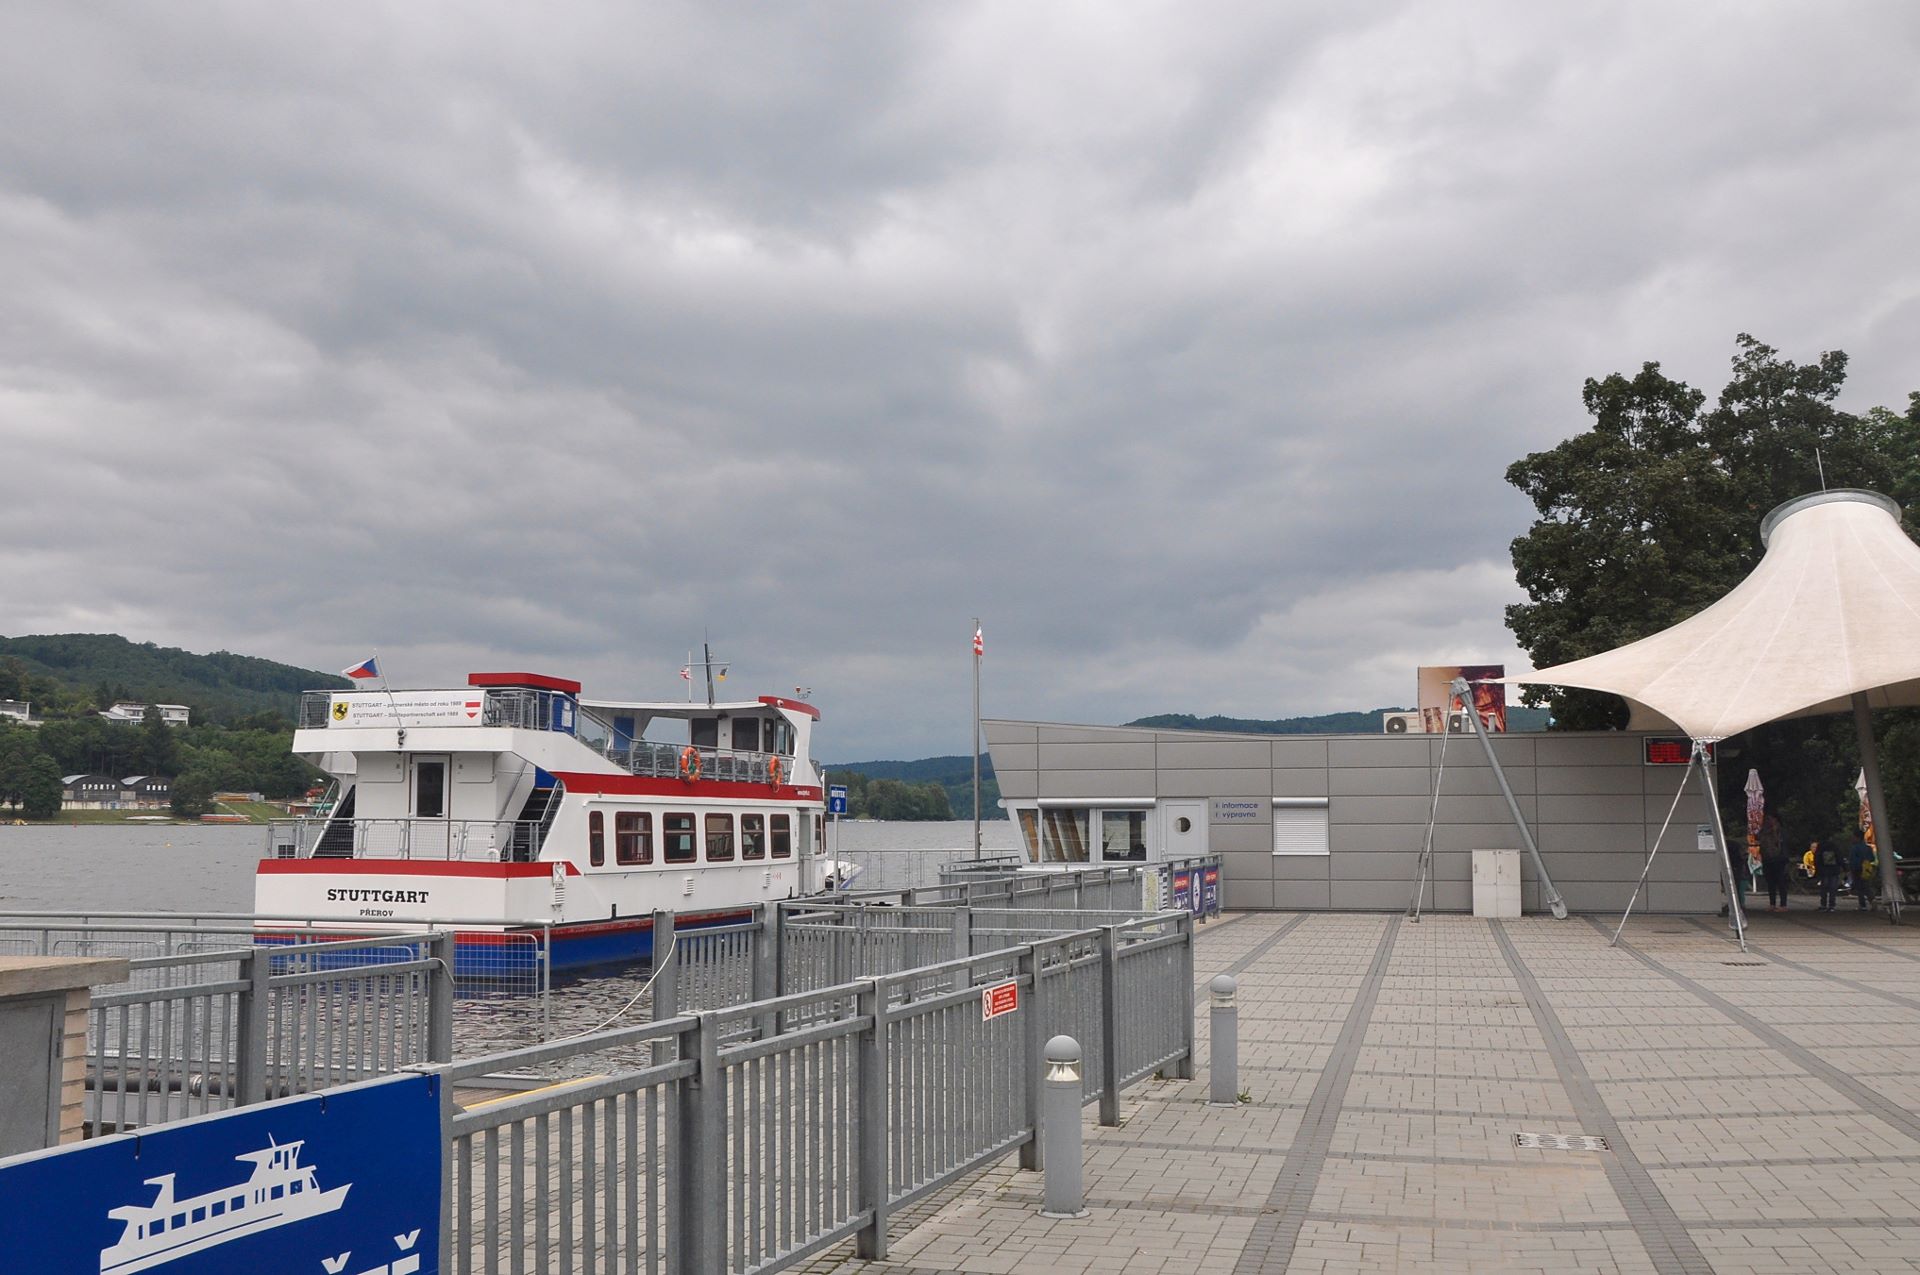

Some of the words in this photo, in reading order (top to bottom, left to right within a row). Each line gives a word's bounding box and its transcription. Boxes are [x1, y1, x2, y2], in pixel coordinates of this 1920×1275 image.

[1222, 811, 1257, 819] výpravna
[327, 888, 429, 903] STUTTGART
[359, 907, 394, 917] PŘEROV
